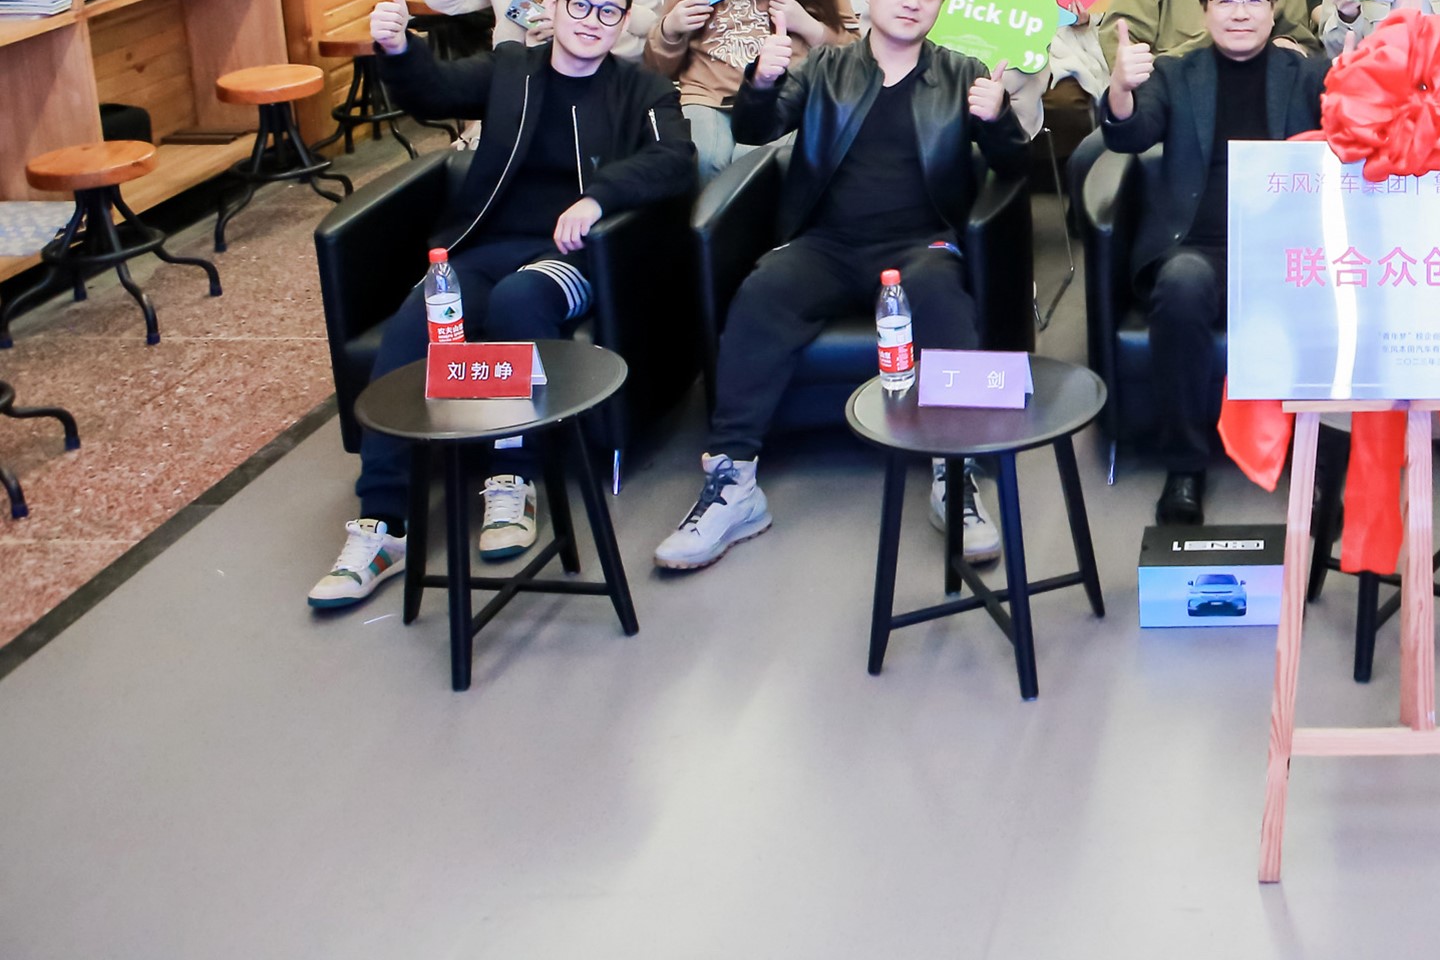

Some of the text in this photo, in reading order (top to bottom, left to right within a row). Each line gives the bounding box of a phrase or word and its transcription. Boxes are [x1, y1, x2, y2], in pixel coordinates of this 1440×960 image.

[1008, 8, 1044, 36] Up
[447, 361, 513, 381] 刘勃峥
